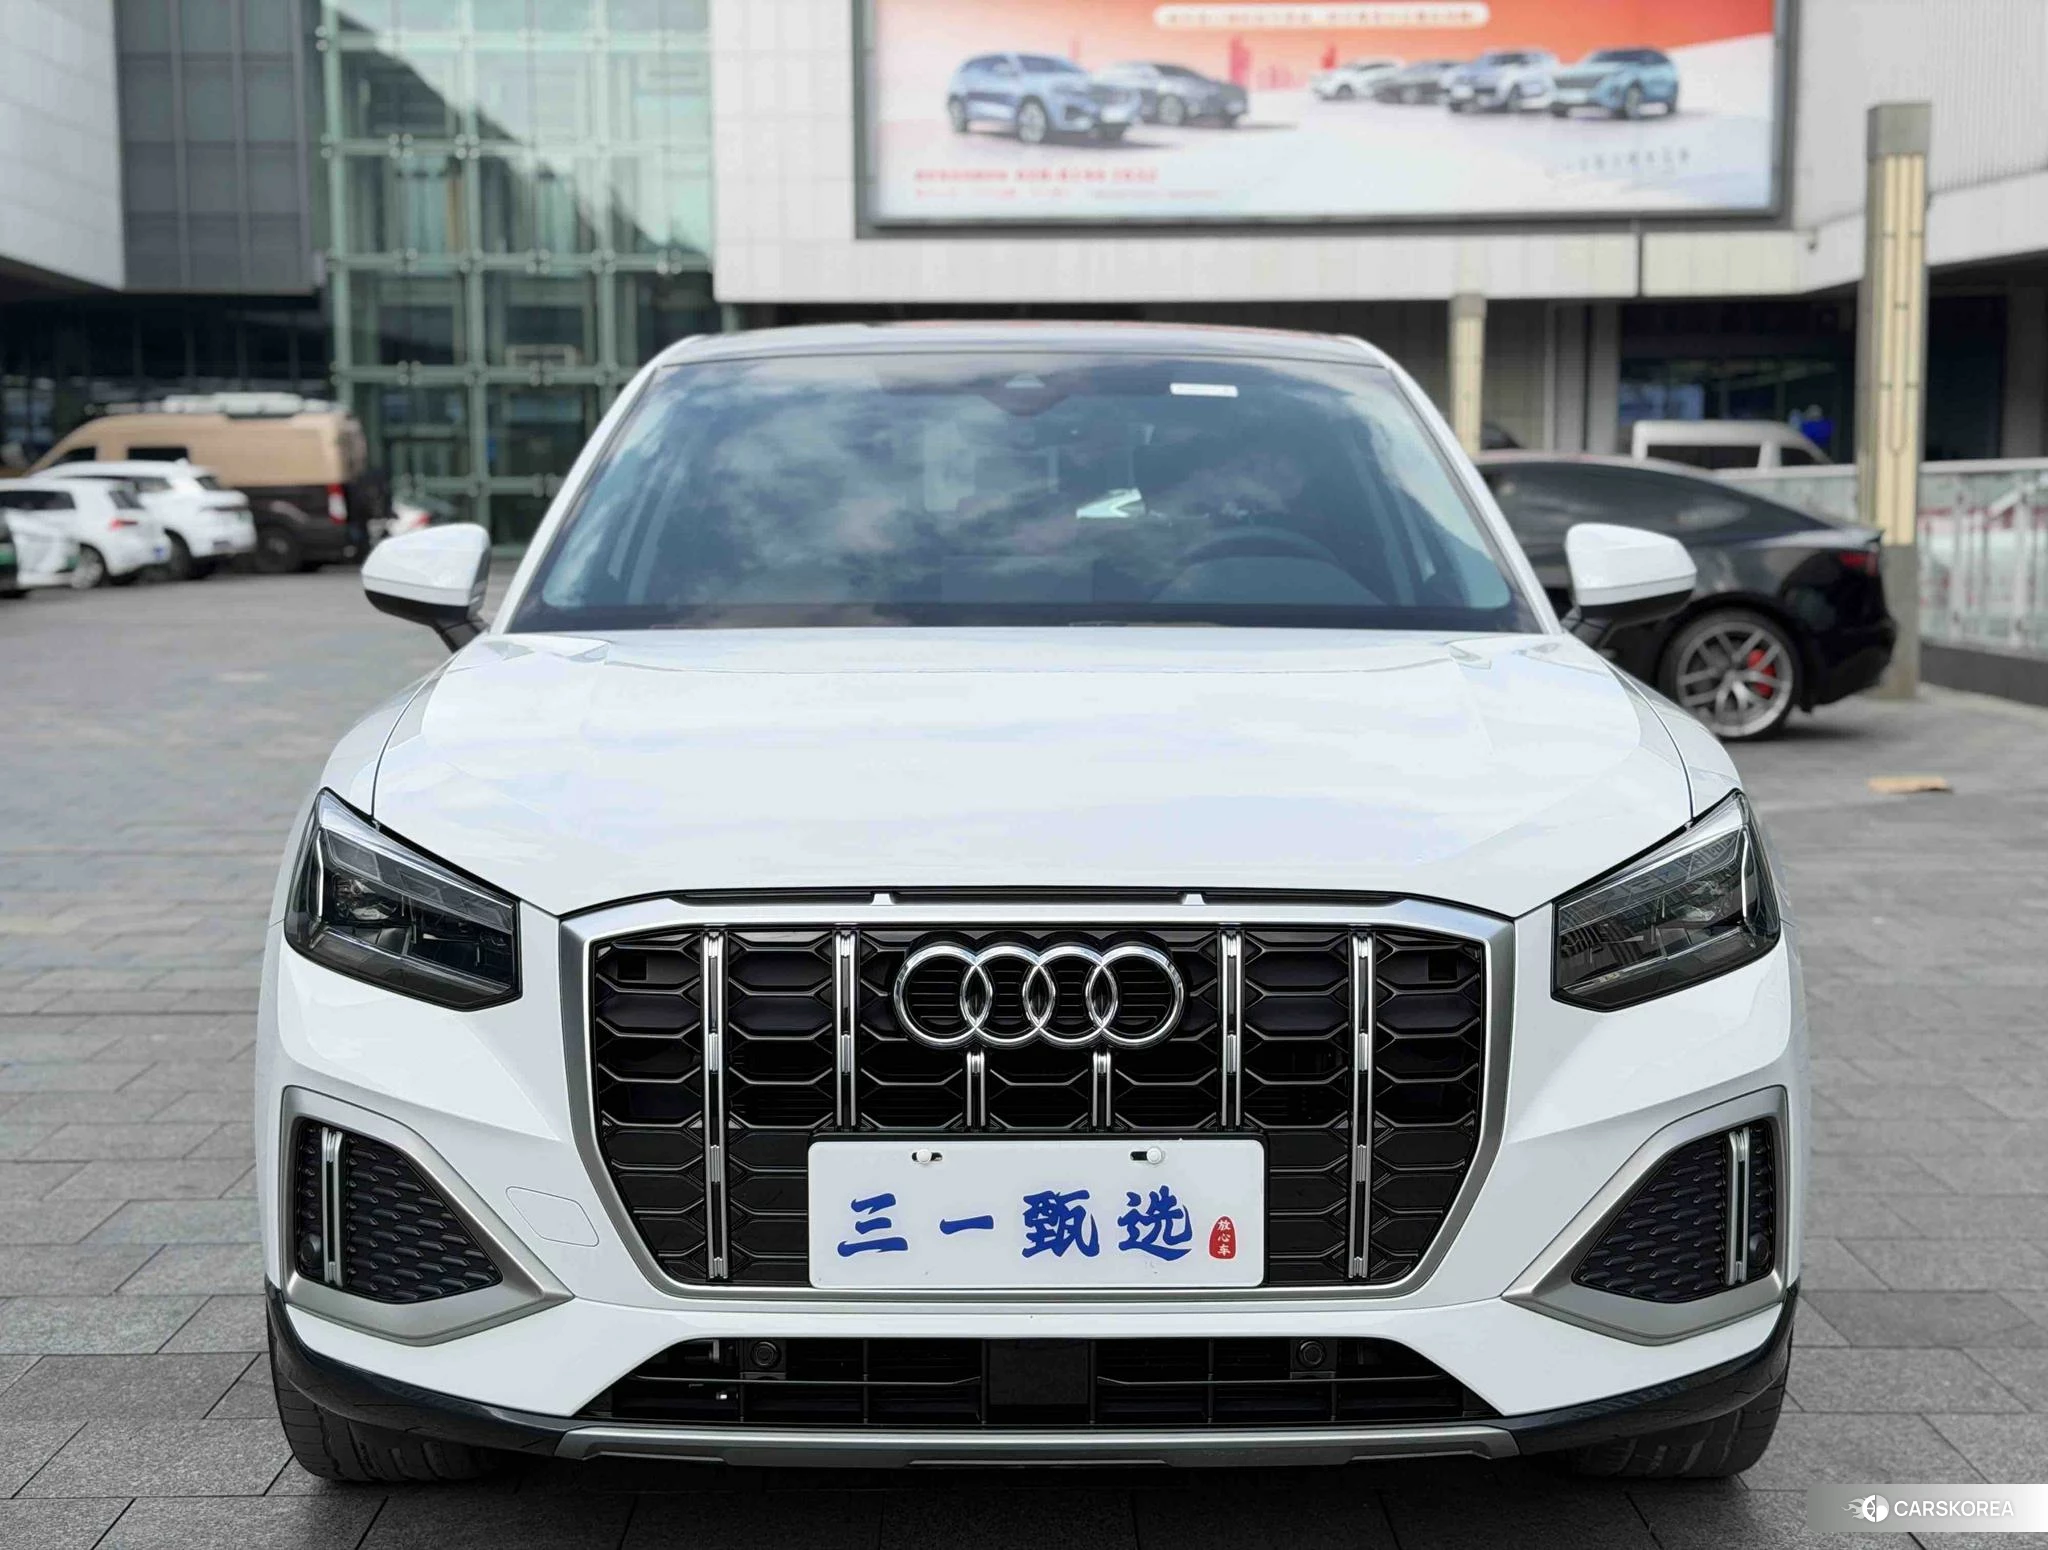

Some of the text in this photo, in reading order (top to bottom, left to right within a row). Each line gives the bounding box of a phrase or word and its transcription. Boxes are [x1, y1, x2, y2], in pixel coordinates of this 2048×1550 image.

[837, 1185, 1193, 1262] 三一甄选
[1216, 1219, 1232, 1256] 放心车
